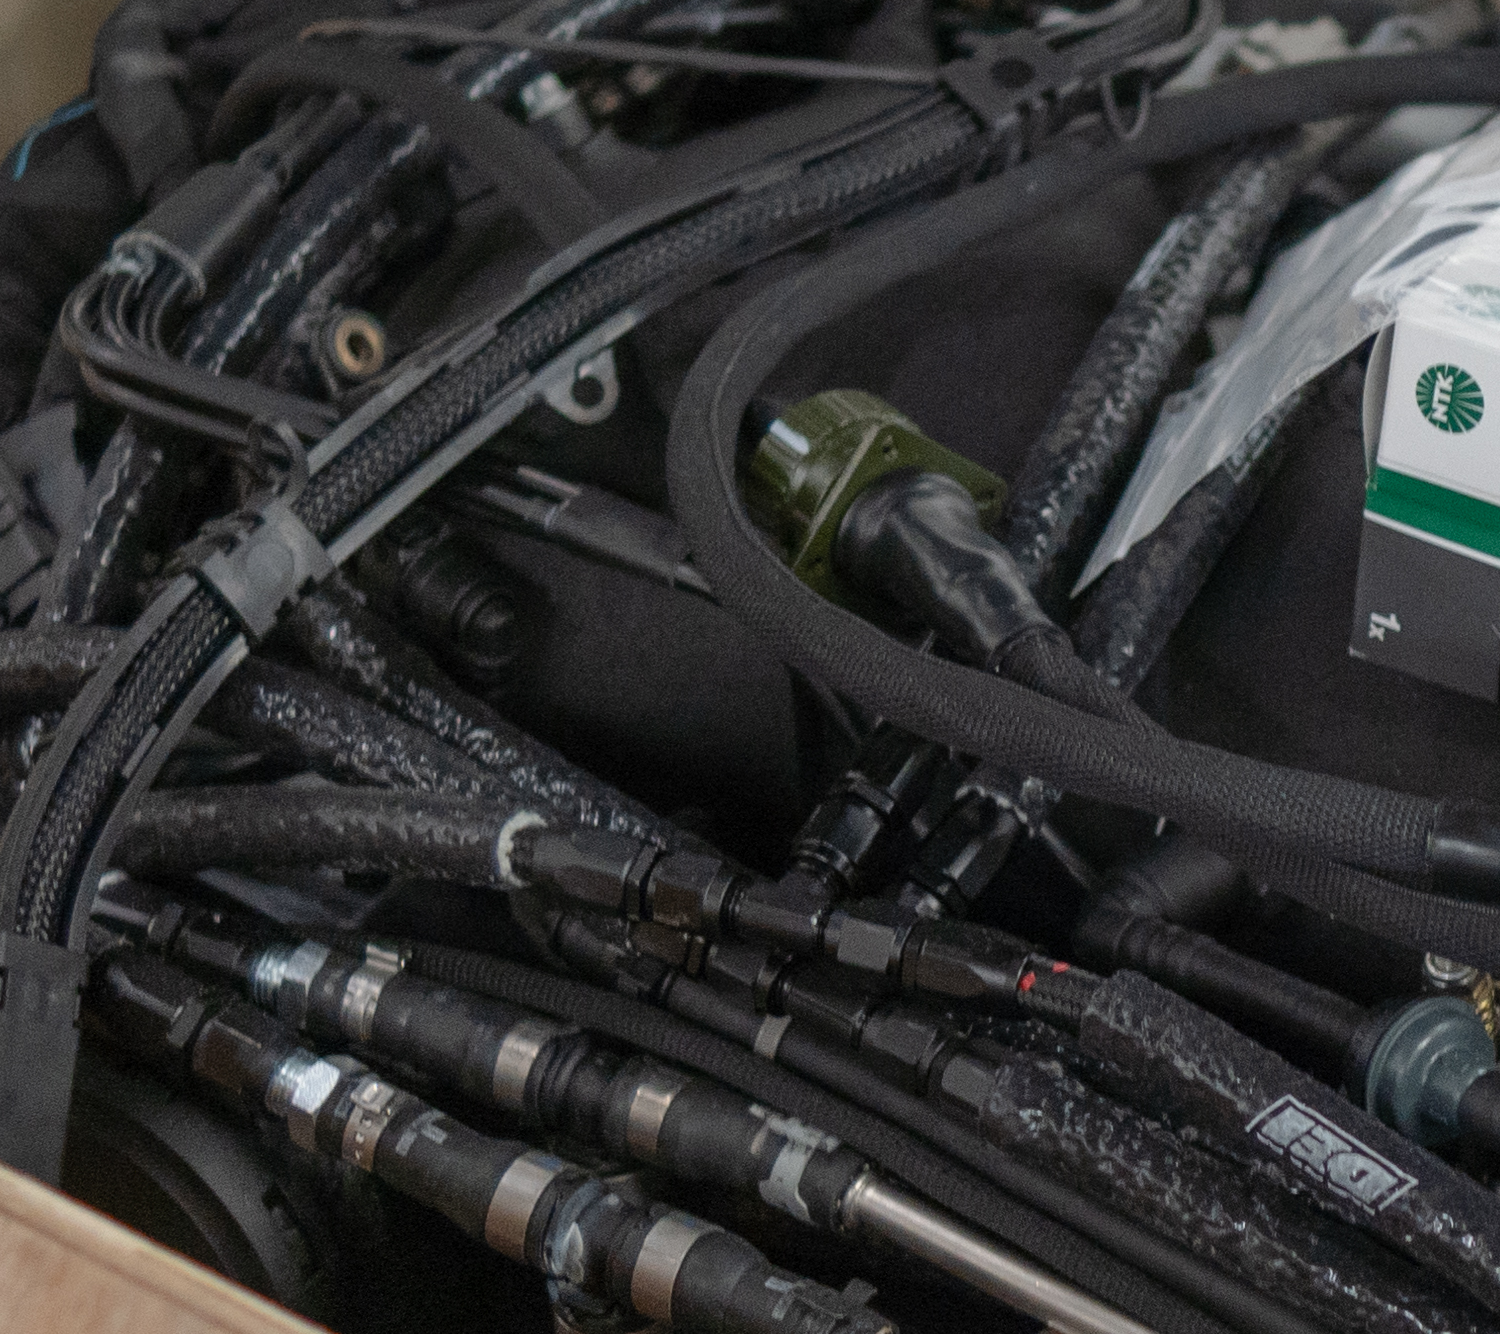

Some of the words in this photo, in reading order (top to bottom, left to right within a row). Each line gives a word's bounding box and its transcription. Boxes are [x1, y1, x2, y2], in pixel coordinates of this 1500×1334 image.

[1430, 370, 1456, 424] NTK
[1368, 611, 1401, 642] 1x
[1254, 1101, 1401, 1217] DEI
